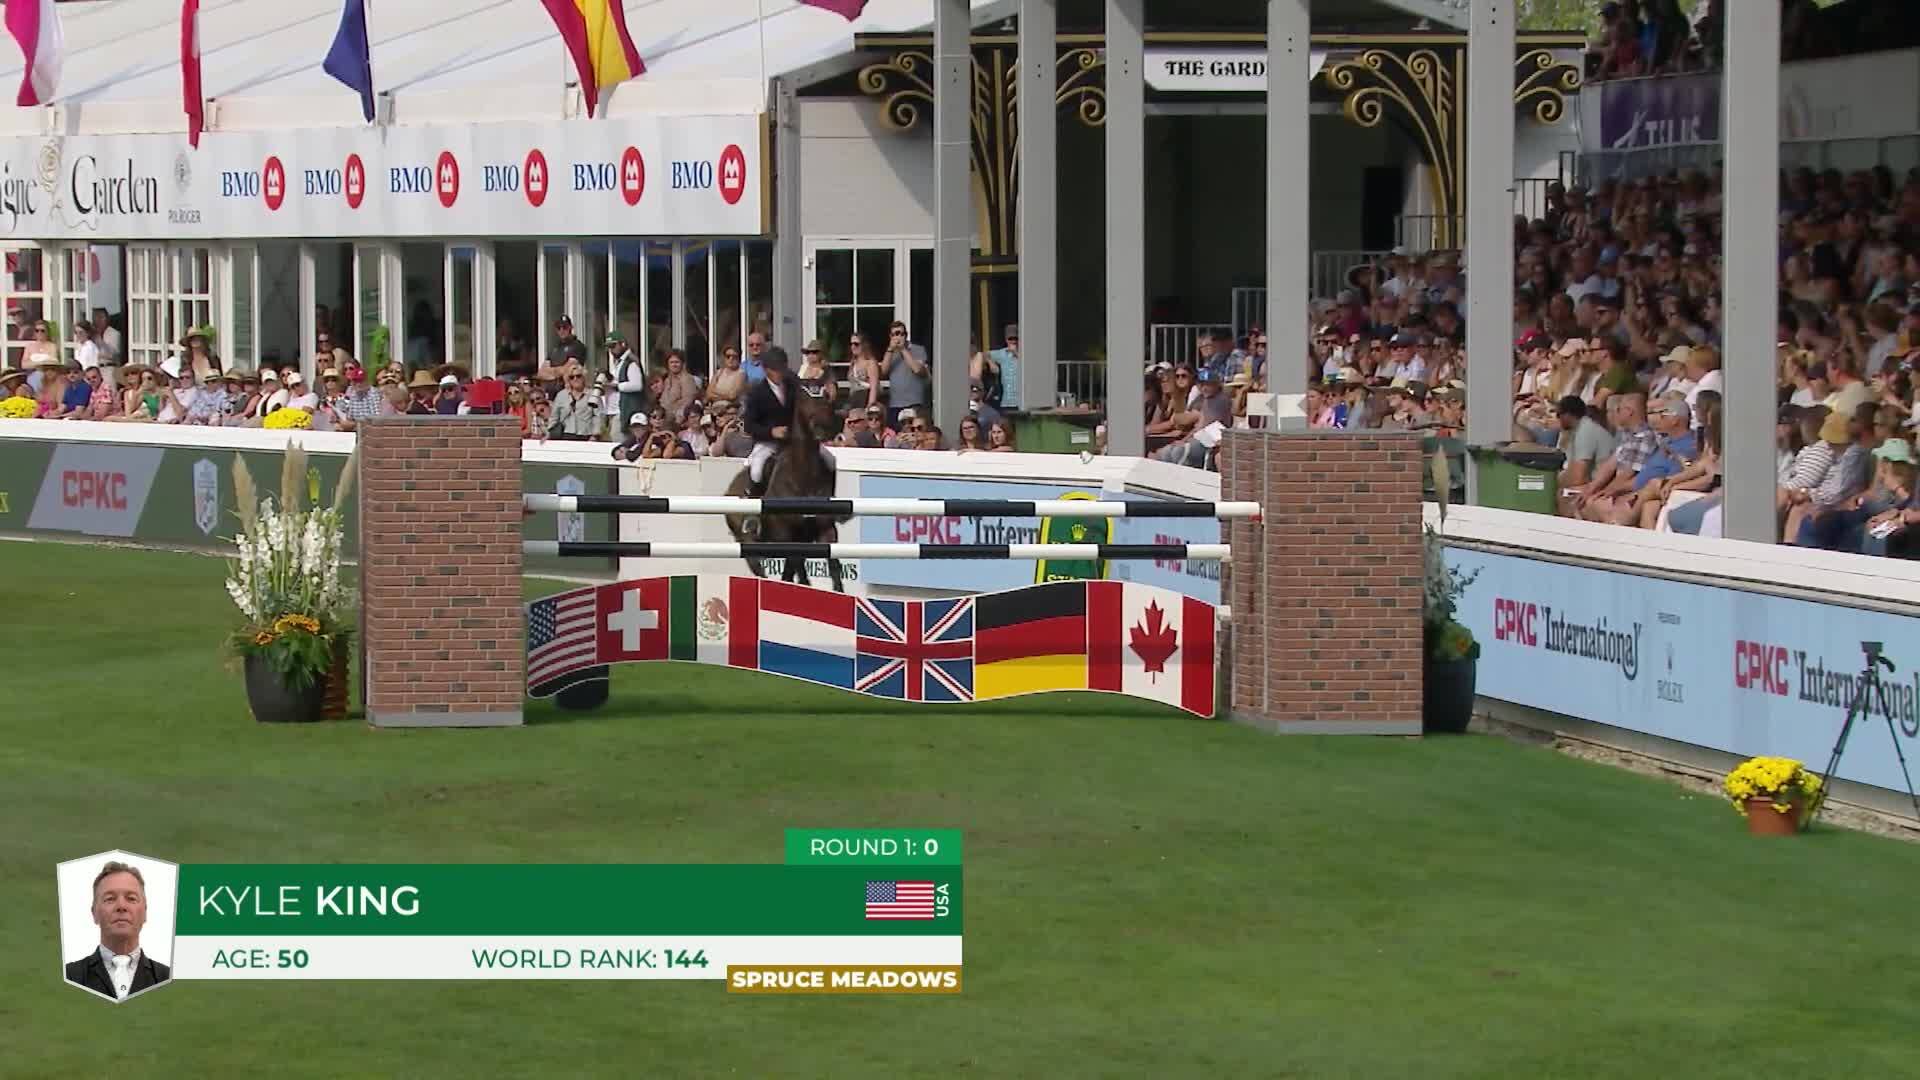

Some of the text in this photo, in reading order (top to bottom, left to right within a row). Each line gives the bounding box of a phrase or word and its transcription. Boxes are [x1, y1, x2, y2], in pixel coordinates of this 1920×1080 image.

[1165, 60, 1204, 77] THE
[71, 155, 159, 215] Garden
[222, 171, 260, 197] BMO
[304, 168, 342, 195] BMO
[390, 166, 433, 193] BMO
[484, 164, 520, 192] BMO
[573, 162, 617, 191] BMO
[671, 160, 713, 189] BMO
[62, 471, 127, 509] CPKC
[896, 514, 961, 545] CPKC
[1495, 598, 1537, 646] CPKC
[1735, 640, 1789, 696] CPKC
